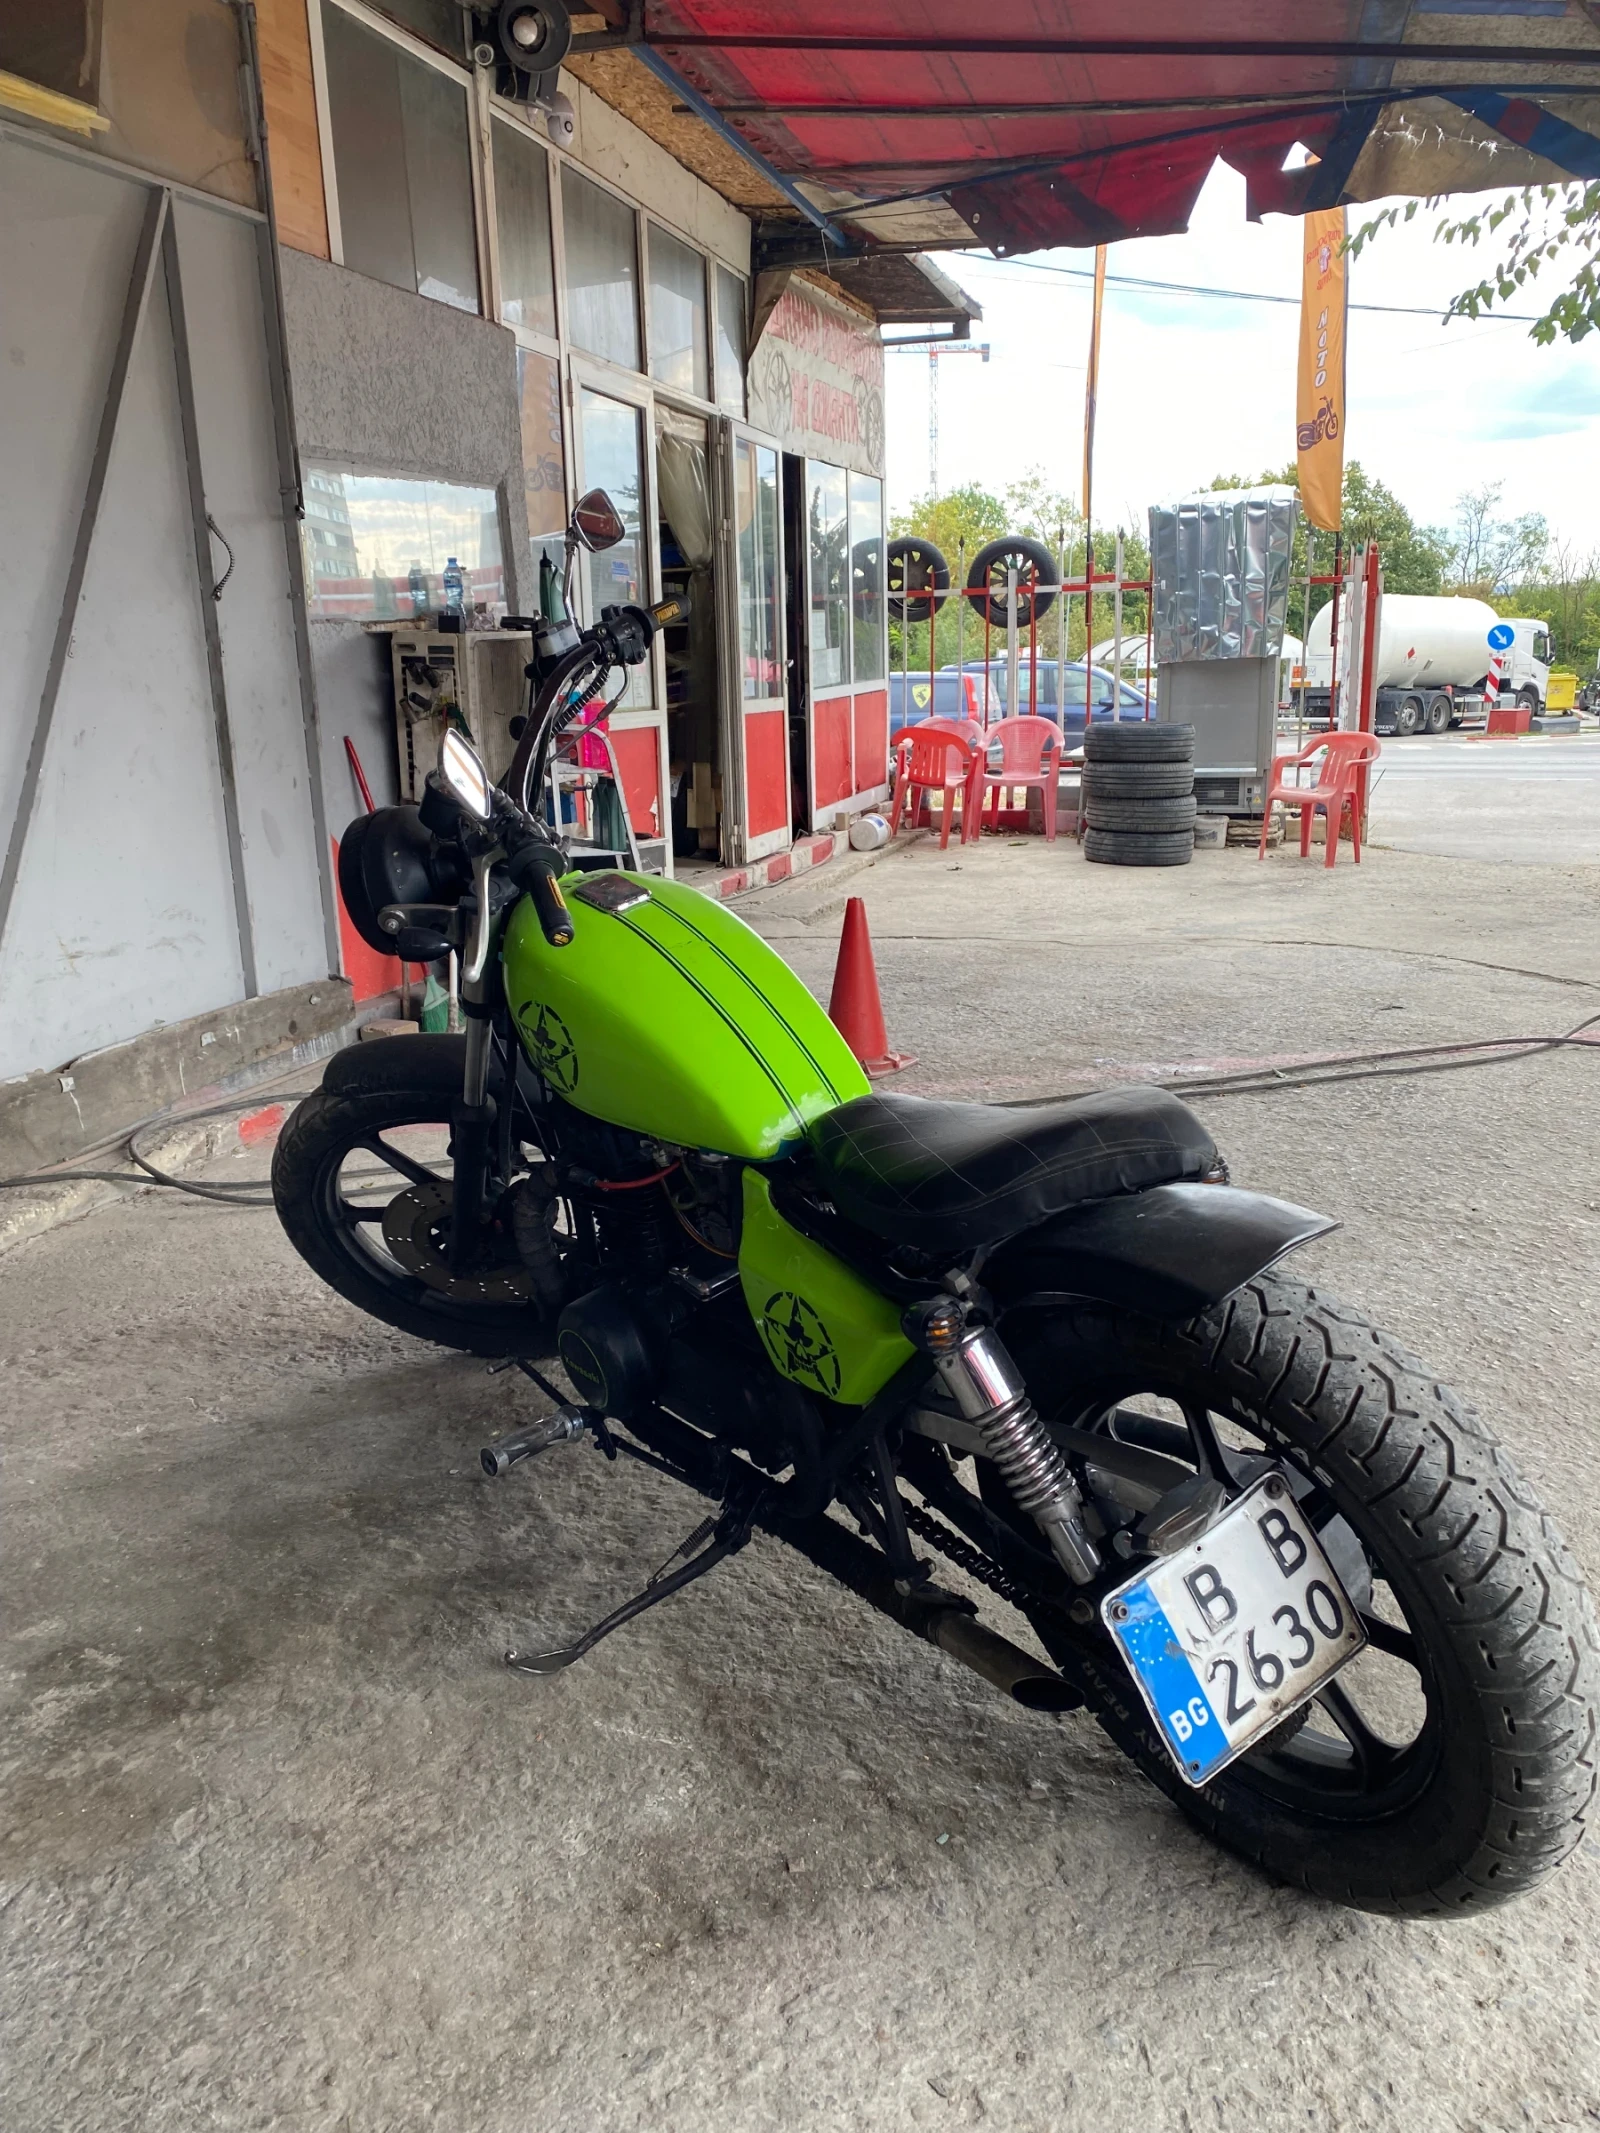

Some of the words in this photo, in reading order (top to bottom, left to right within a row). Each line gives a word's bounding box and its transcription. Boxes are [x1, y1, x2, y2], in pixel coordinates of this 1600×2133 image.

[1315, 305, 1329, 388] MOTO
[563, 1354, 600, 1385] Kawasaki
[1231, 1396, 1335, 1488] MITAS
[1183, 1563, 1238, 1635] B
[1257, 1508, 1308, 1579] B
[1208, 1579, 1344, 1726] 2630
[1169, 1697, 1209, 1743] BG
[1133, 1728, 1226, 1811] HIWAY
